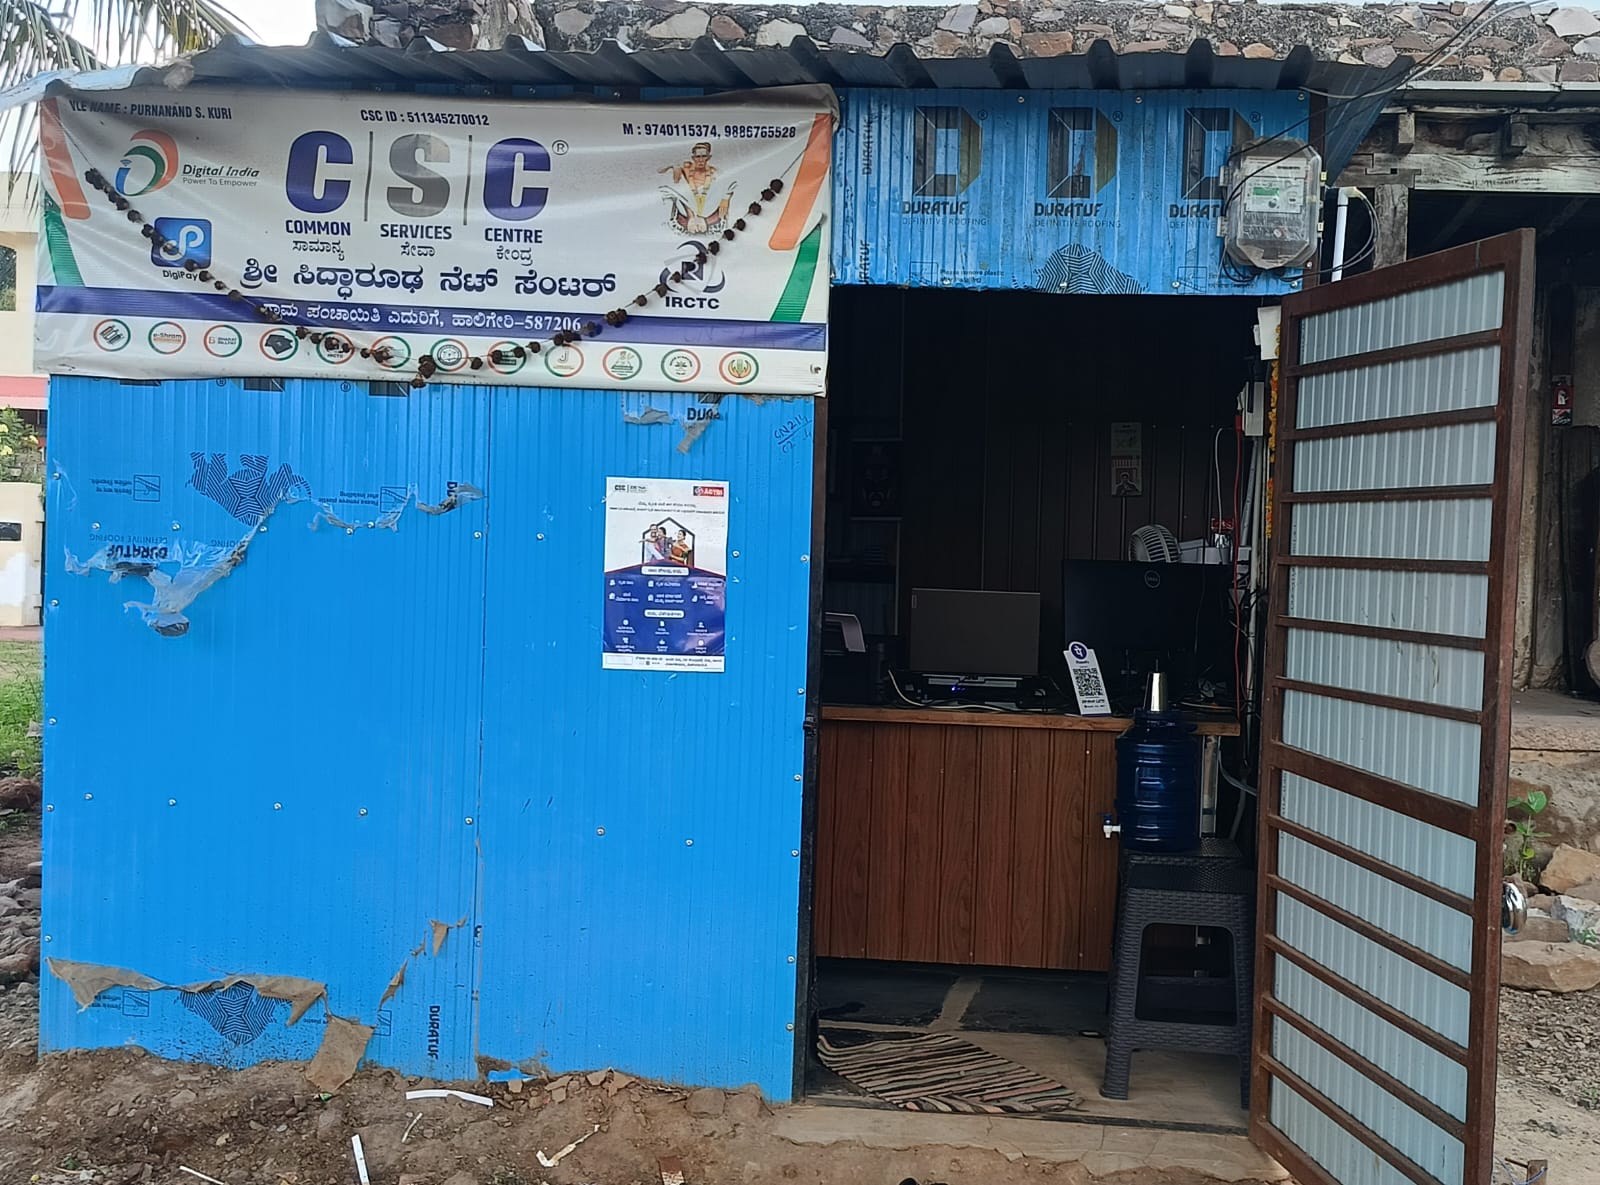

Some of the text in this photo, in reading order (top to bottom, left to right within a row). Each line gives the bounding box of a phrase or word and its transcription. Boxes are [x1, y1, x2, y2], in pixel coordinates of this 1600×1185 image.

[90, 103, 120, 115] NAME
[130, 104, 192, 119] PURNANAND
[195, 106, 205, 119] S.
[208, 107, 232, 120] KURI
[360, 109, 383, 122] CSC
[385, 110, 397, 122] ID
[406, 111, 490, 126] 511345270012
[622, 123, 634, 136] M
[724, 125, 797, 139] 9886765528
[862, 115, 874, 176] DURATUF
[182, 164, 260, 178] Digital India
[182, 177, 206, 185] Power
[219, 178, 258, 187] Empower
[901, 199, 969, 217] DURATUF
[1034, 202, 1104, 219] DURATUF
[1169, 204, 1221, 220] DURAT
[285, 219, 543, 244] COMMON SERVICES CENTRE
[291, 239, 533, 267] ಸಾಮಾನ್ಯ ಸೇವಾ ಕೇಂದ್ರ
[859, 239, 871, 285] URATUF
[162, 269, 198, 281] DigiPay
[239, 258, 278, 289] ಶ್ರೀ
[440, 266, 498, 293] ನೆಟ್
[515, 269, 616, 297] ಸೆಂಟರ್
[665, 296, 720, 310] IRCTC
[427, 1005, 441, 1060] DURATUF
